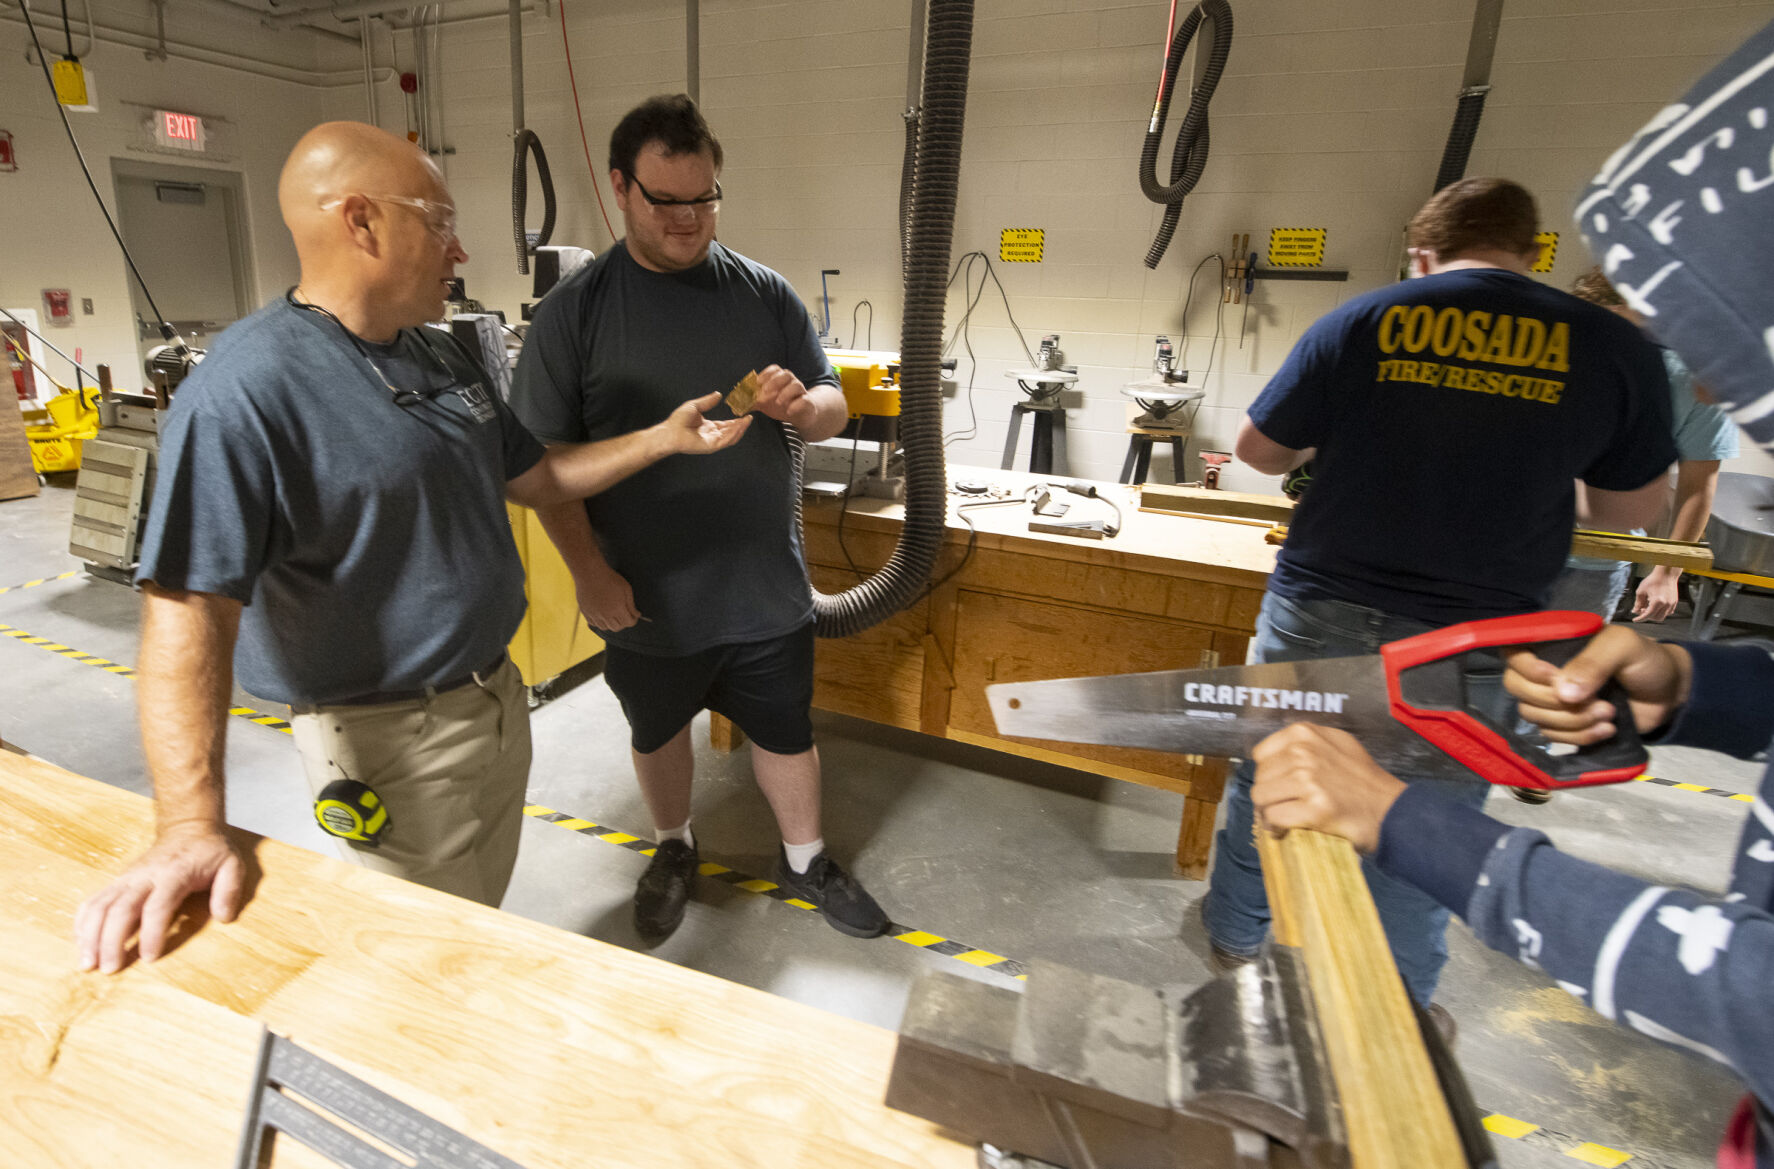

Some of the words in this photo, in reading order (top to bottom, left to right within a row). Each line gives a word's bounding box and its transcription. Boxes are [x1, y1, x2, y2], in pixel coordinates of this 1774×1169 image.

[165, 112, 197, 140] EXIT
[1377, 304, 1571, 373] COOSADA
[1376, 359, 1565, 404] FIRE/RESCUE
[1184, 682, 1347, 714] CRAFTSMAN
